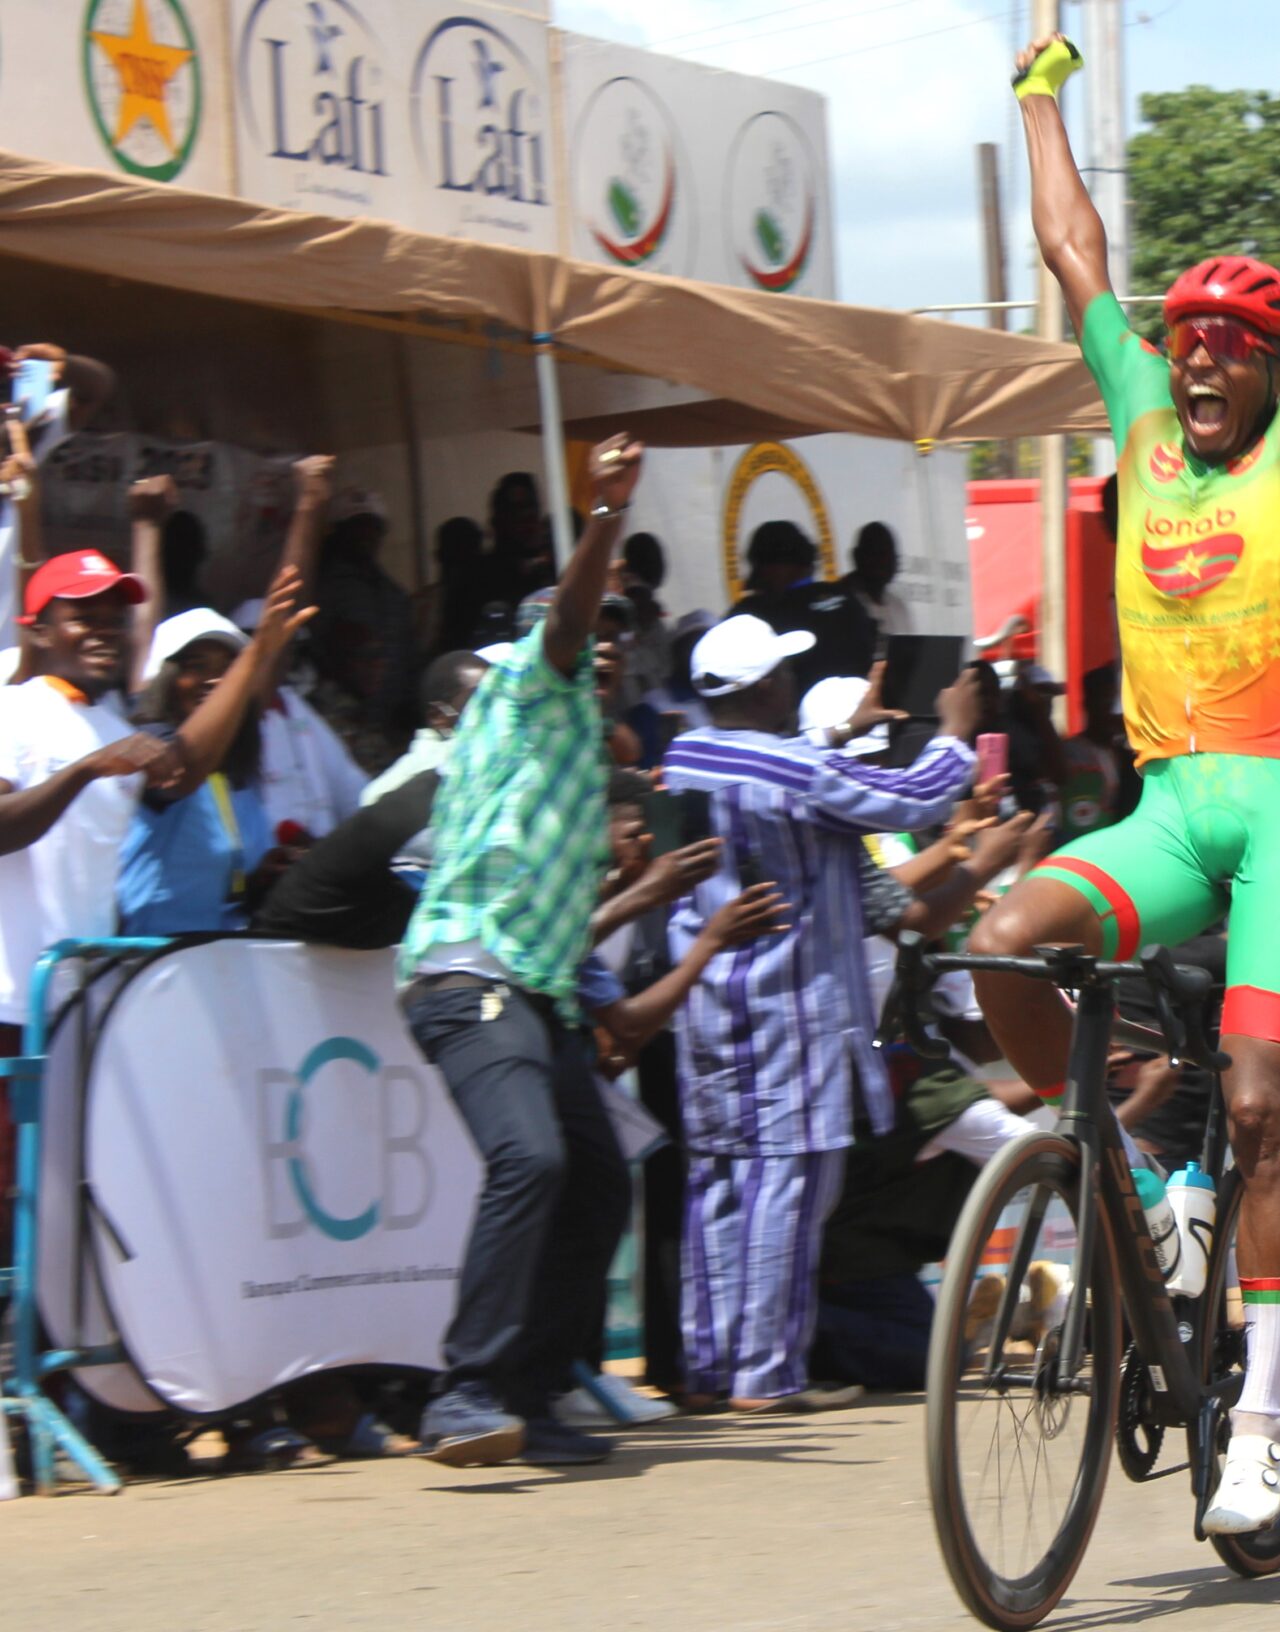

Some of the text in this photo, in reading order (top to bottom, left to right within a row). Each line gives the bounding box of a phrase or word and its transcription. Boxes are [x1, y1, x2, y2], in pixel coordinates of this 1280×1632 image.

[262, 38, 391, 177] Lafi
[432, 75, 552, 206] Lafi
[1144, 508, 1237, 536] lonab
[256, 1036, 438, 1242] BCB
